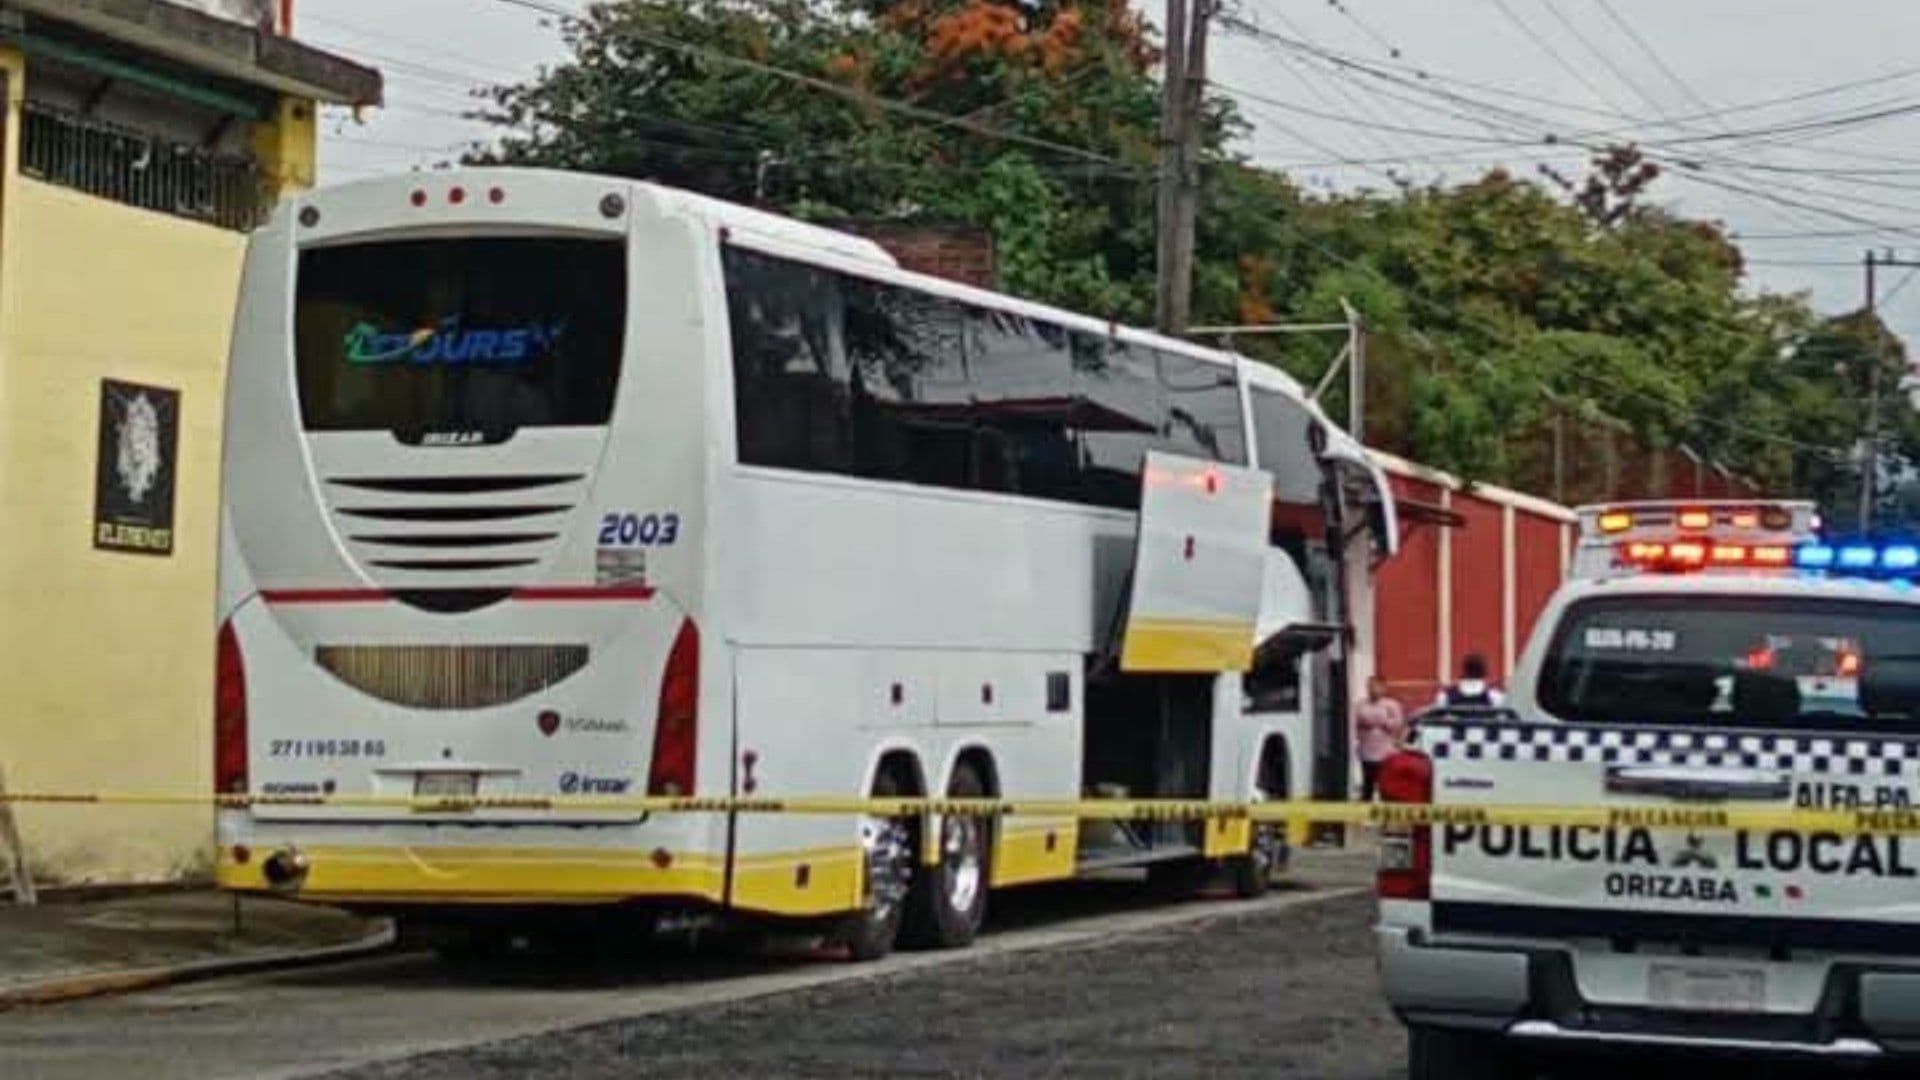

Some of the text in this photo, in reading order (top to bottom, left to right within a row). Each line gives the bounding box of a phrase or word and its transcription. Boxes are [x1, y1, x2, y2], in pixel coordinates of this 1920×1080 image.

[598, 513, 679, 545] 2003
[1736, 829, 1917, 877] LOCAL
[1606, 873, 1738, 902] ORIZABA
